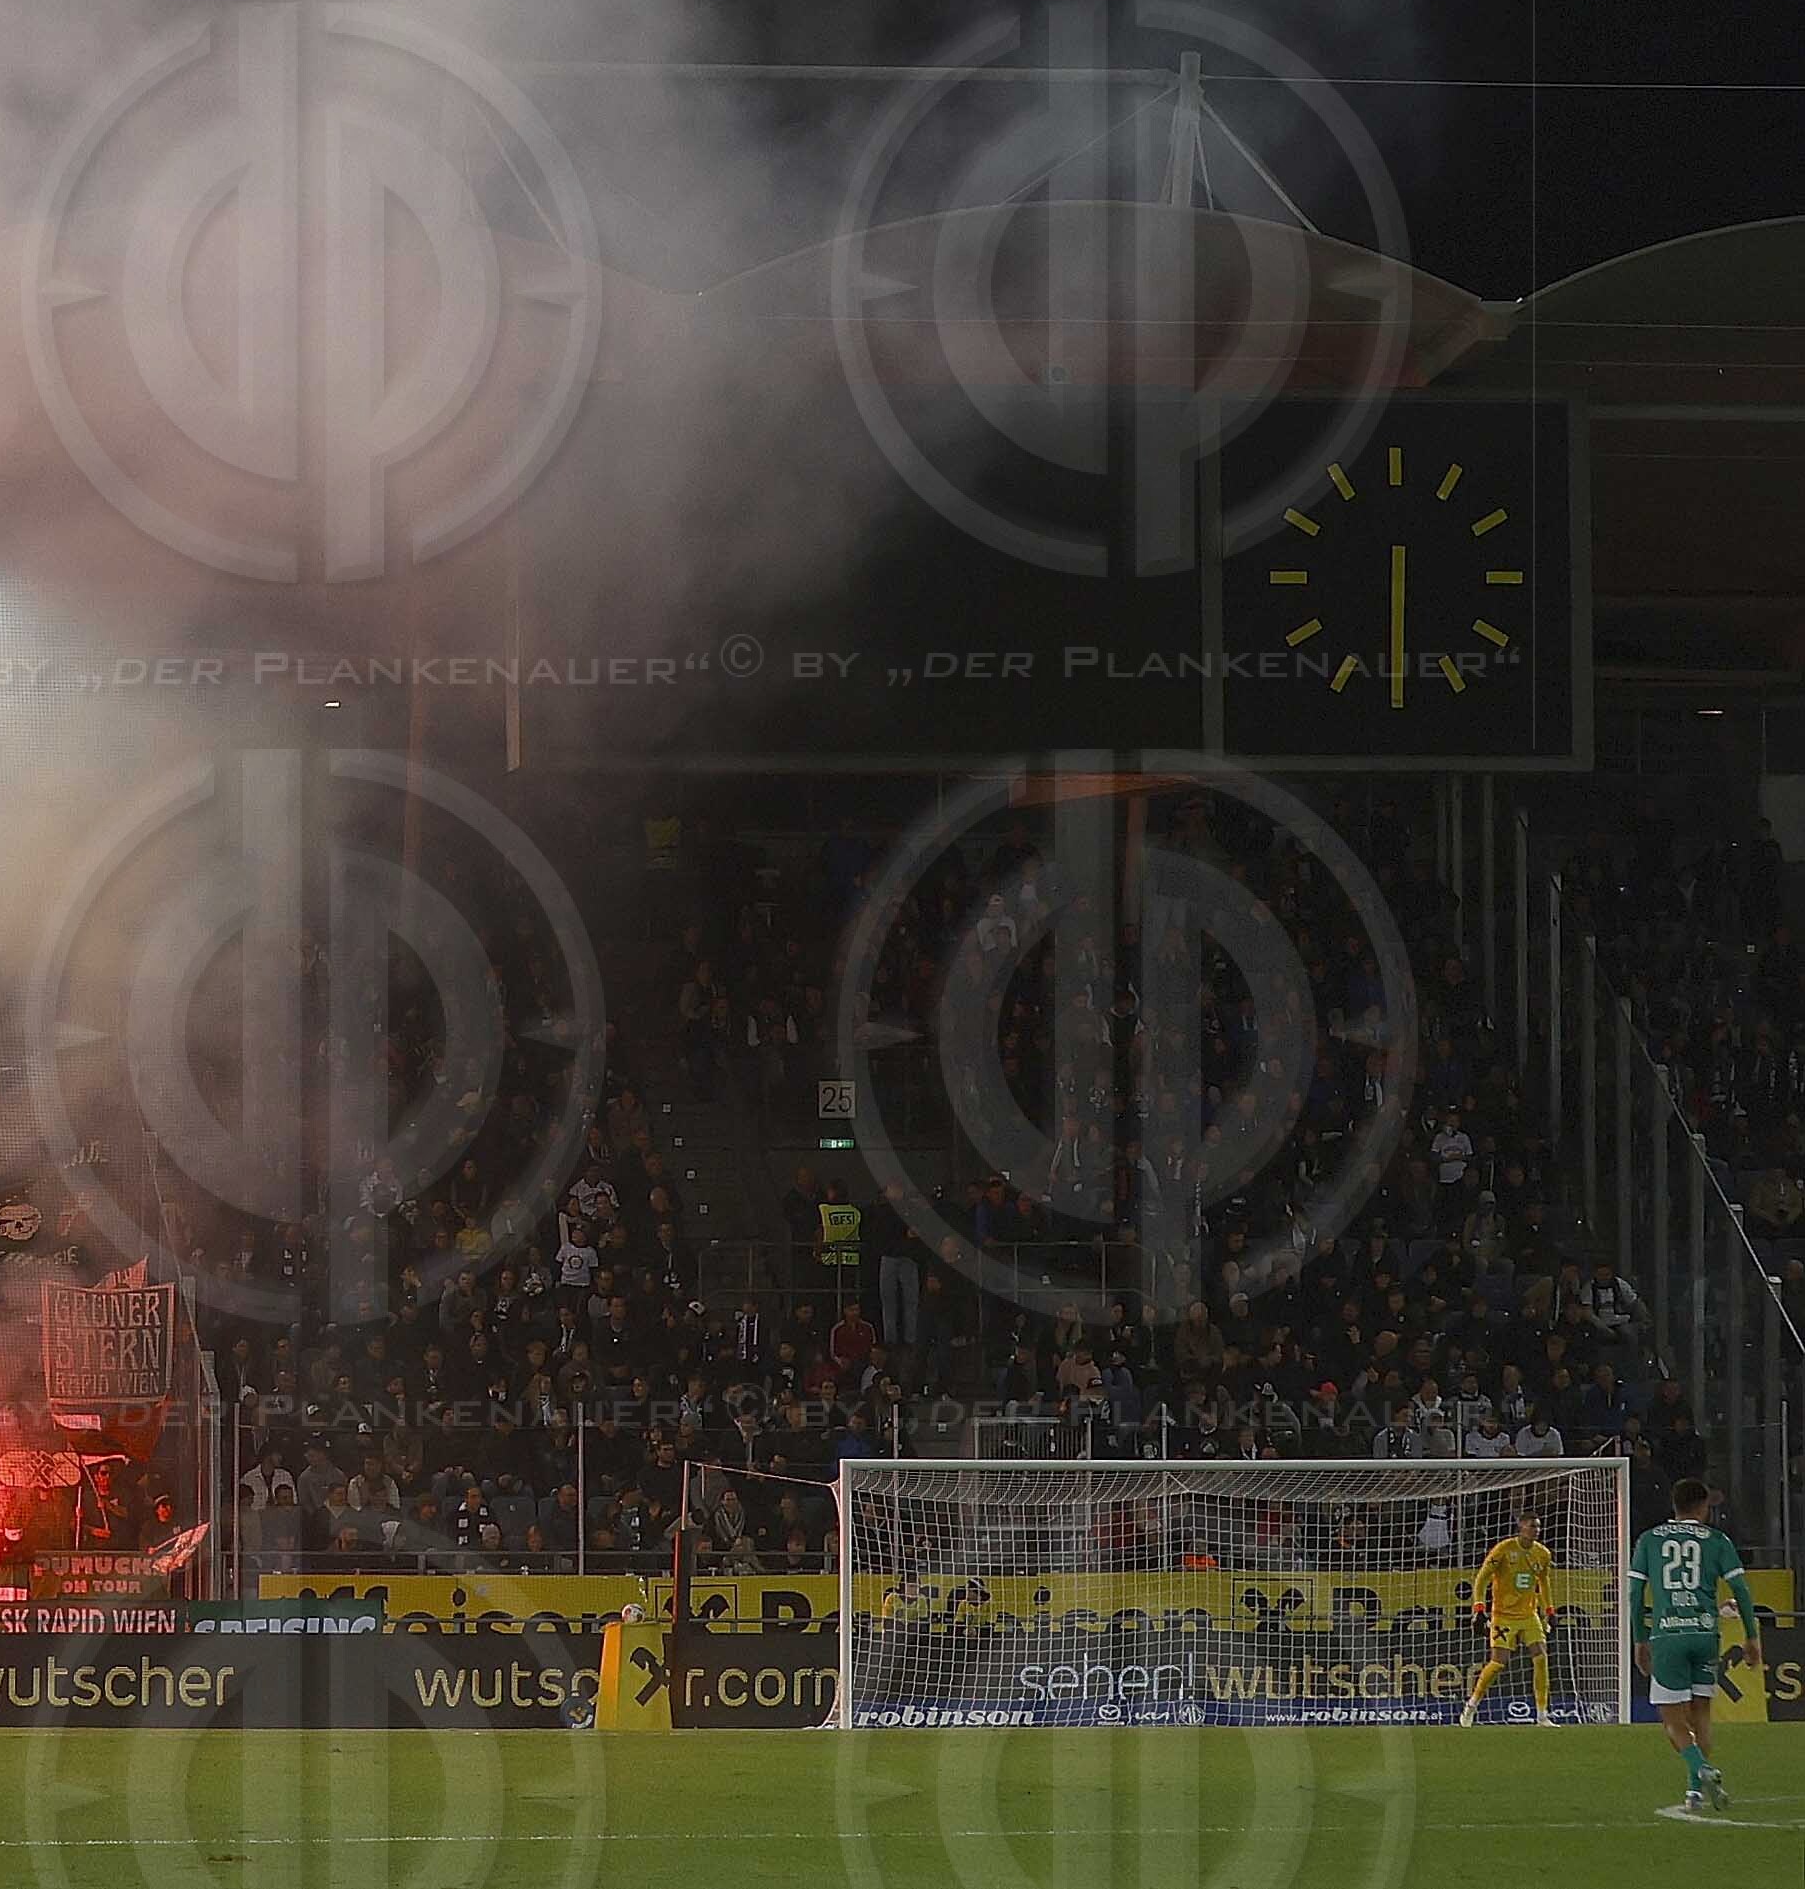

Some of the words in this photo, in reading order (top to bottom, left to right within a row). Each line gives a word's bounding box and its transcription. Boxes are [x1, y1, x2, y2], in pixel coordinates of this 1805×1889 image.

[822, 1087, 852, 1112] 25
[56, 1328, 161, 1370] STERN
[1661, 1540, 1701, 1590] 23
[1, 1608, 28, 1633] SK
[37, 1608, 105, 1633] RAPID
[113, 1608, 176, 1633] WIEN
[1018, 1652, 1194, 1700] sehen!
[1205, 1653, 1488, 1701] wutscher
[857, 1704, 1034, 1728] robinson
